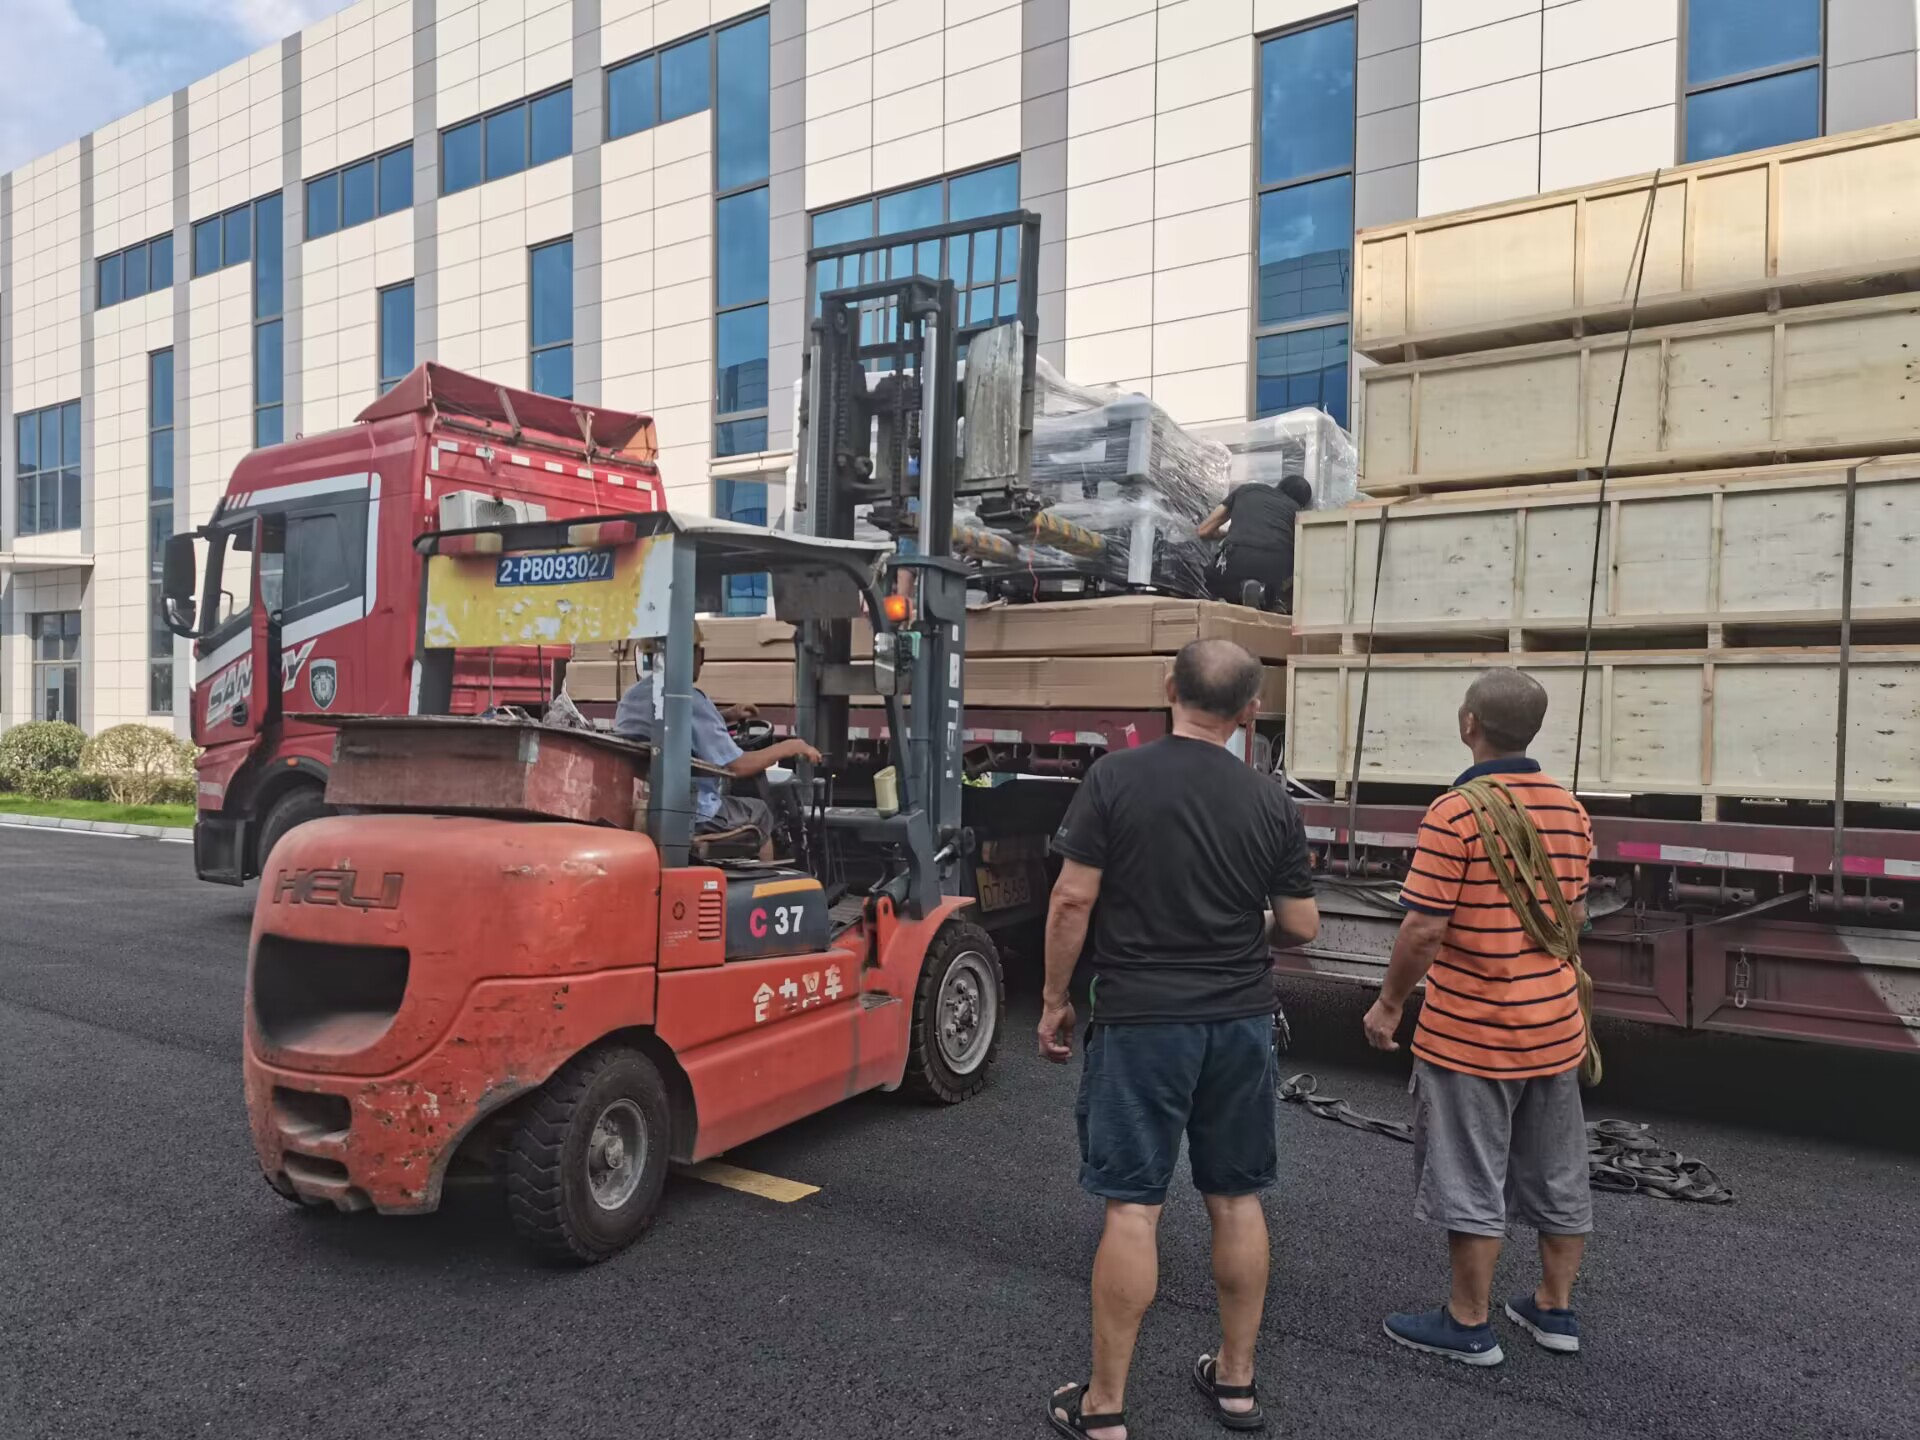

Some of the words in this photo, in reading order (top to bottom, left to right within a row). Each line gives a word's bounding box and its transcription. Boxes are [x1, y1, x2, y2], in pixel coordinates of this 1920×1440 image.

[499, 551, 610, 584] 2-PB093027
[272, 868, 404, 910] HELI
[750, 908, 768, 938] C
[774, 905, 804, 935] 37
